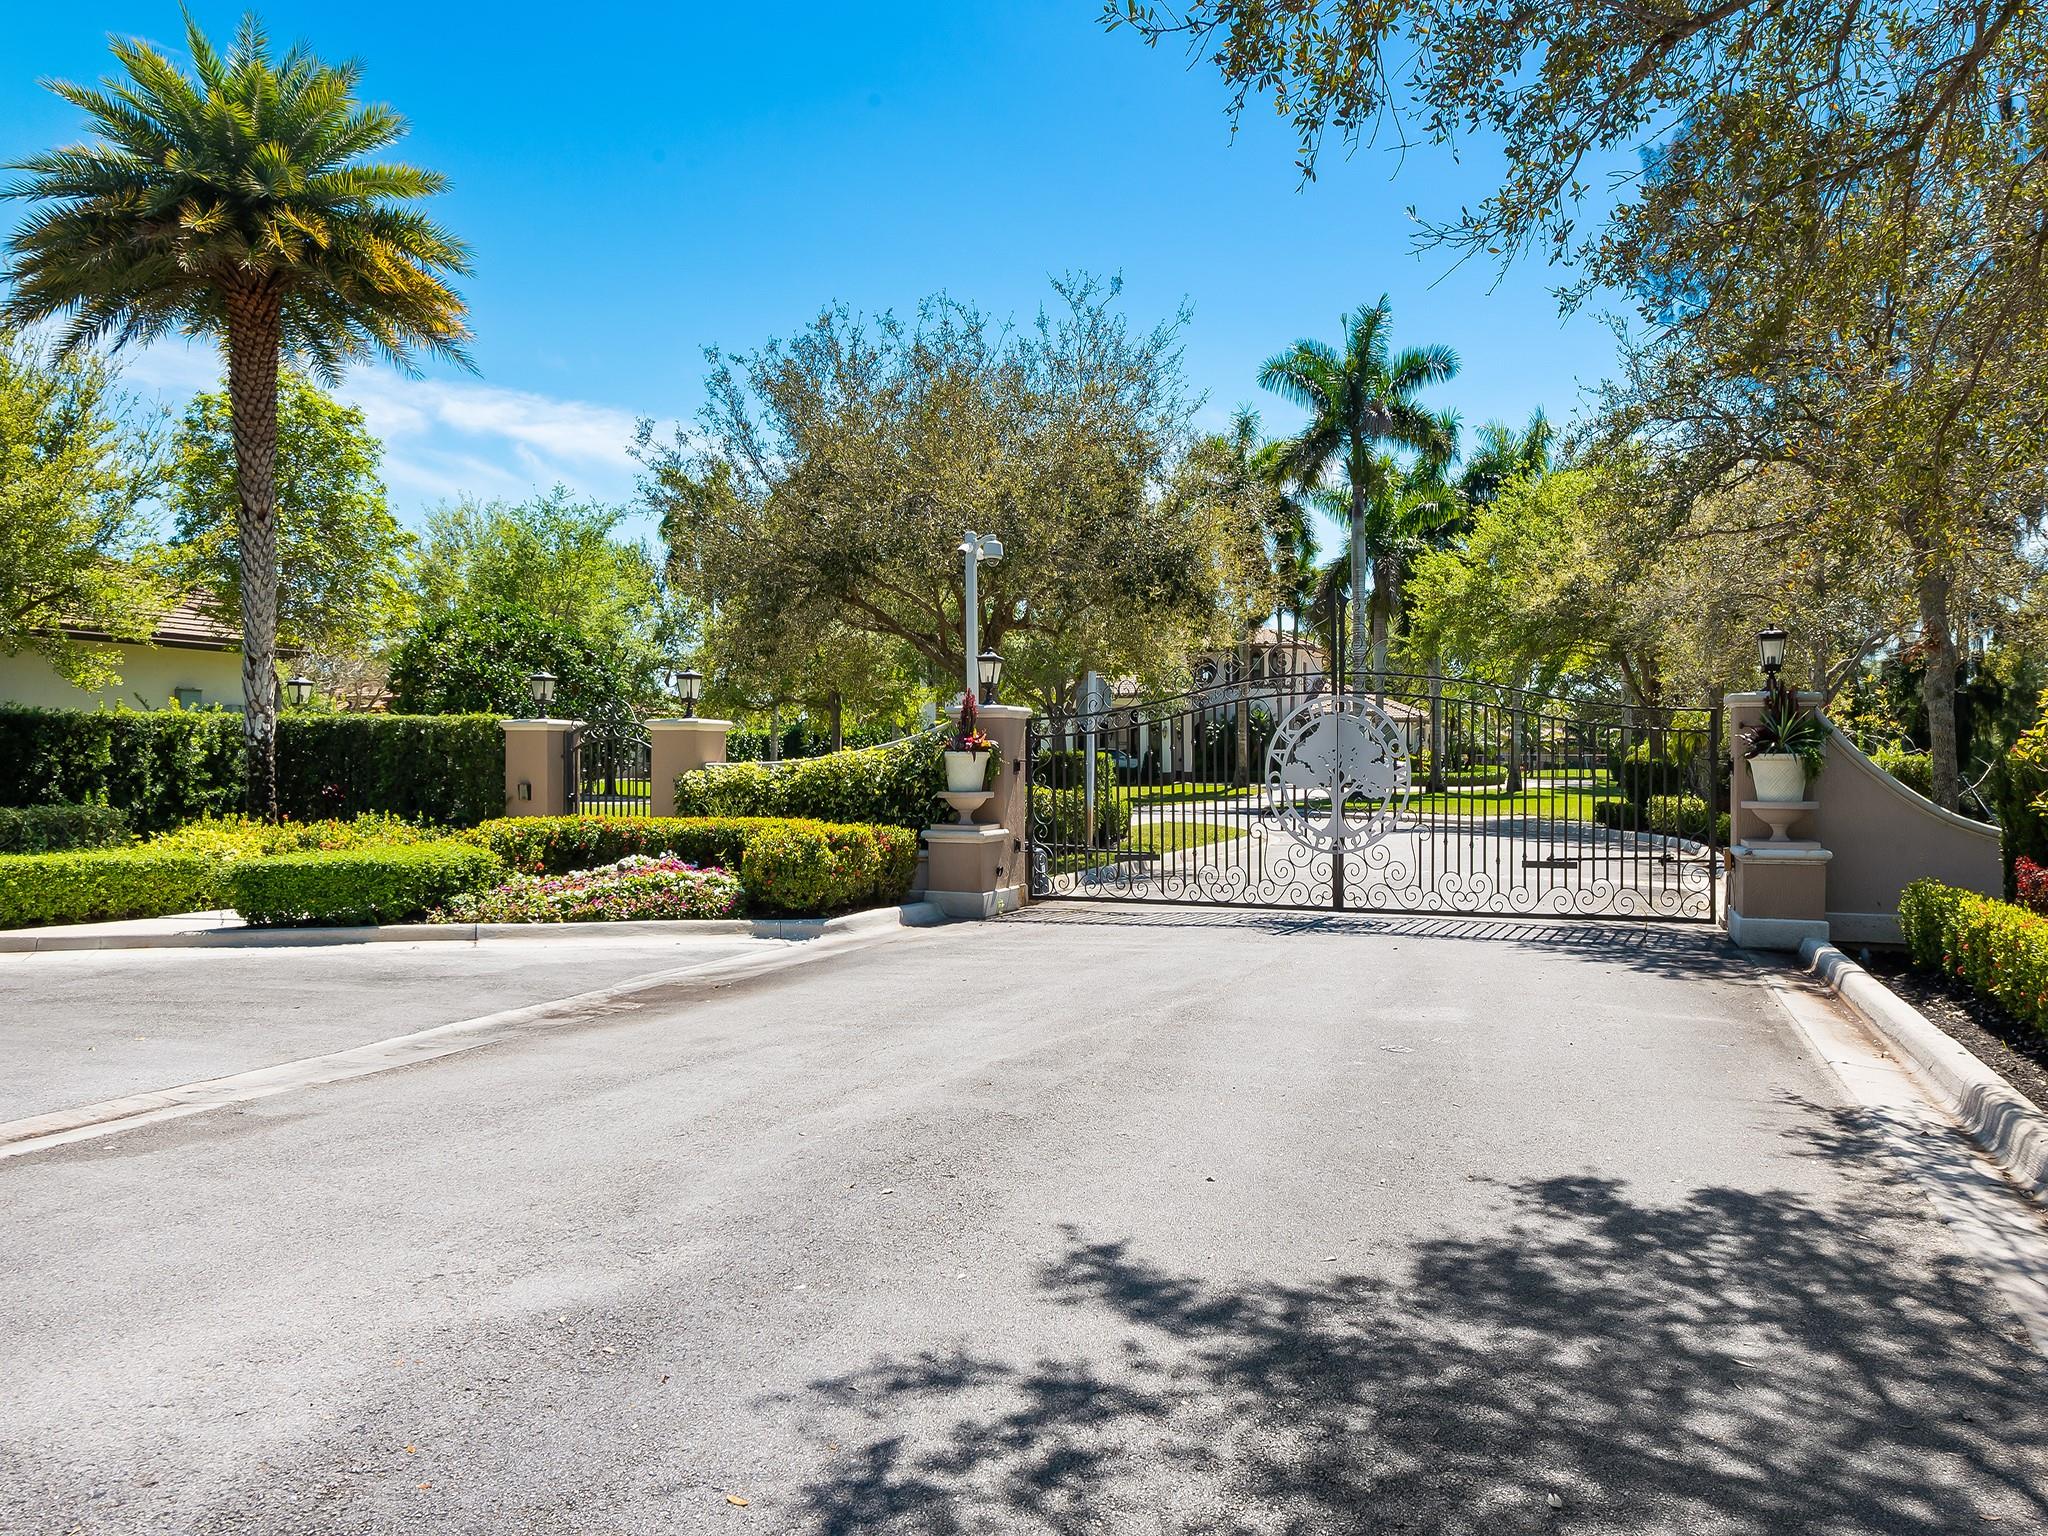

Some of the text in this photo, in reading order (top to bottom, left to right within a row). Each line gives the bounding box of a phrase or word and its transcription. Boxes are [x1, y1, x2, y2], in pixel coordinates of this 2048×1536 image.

[1268, 697, 1408, 790] OAK HOLLOW
[1279, 809, 1394, 851] ESTATES
